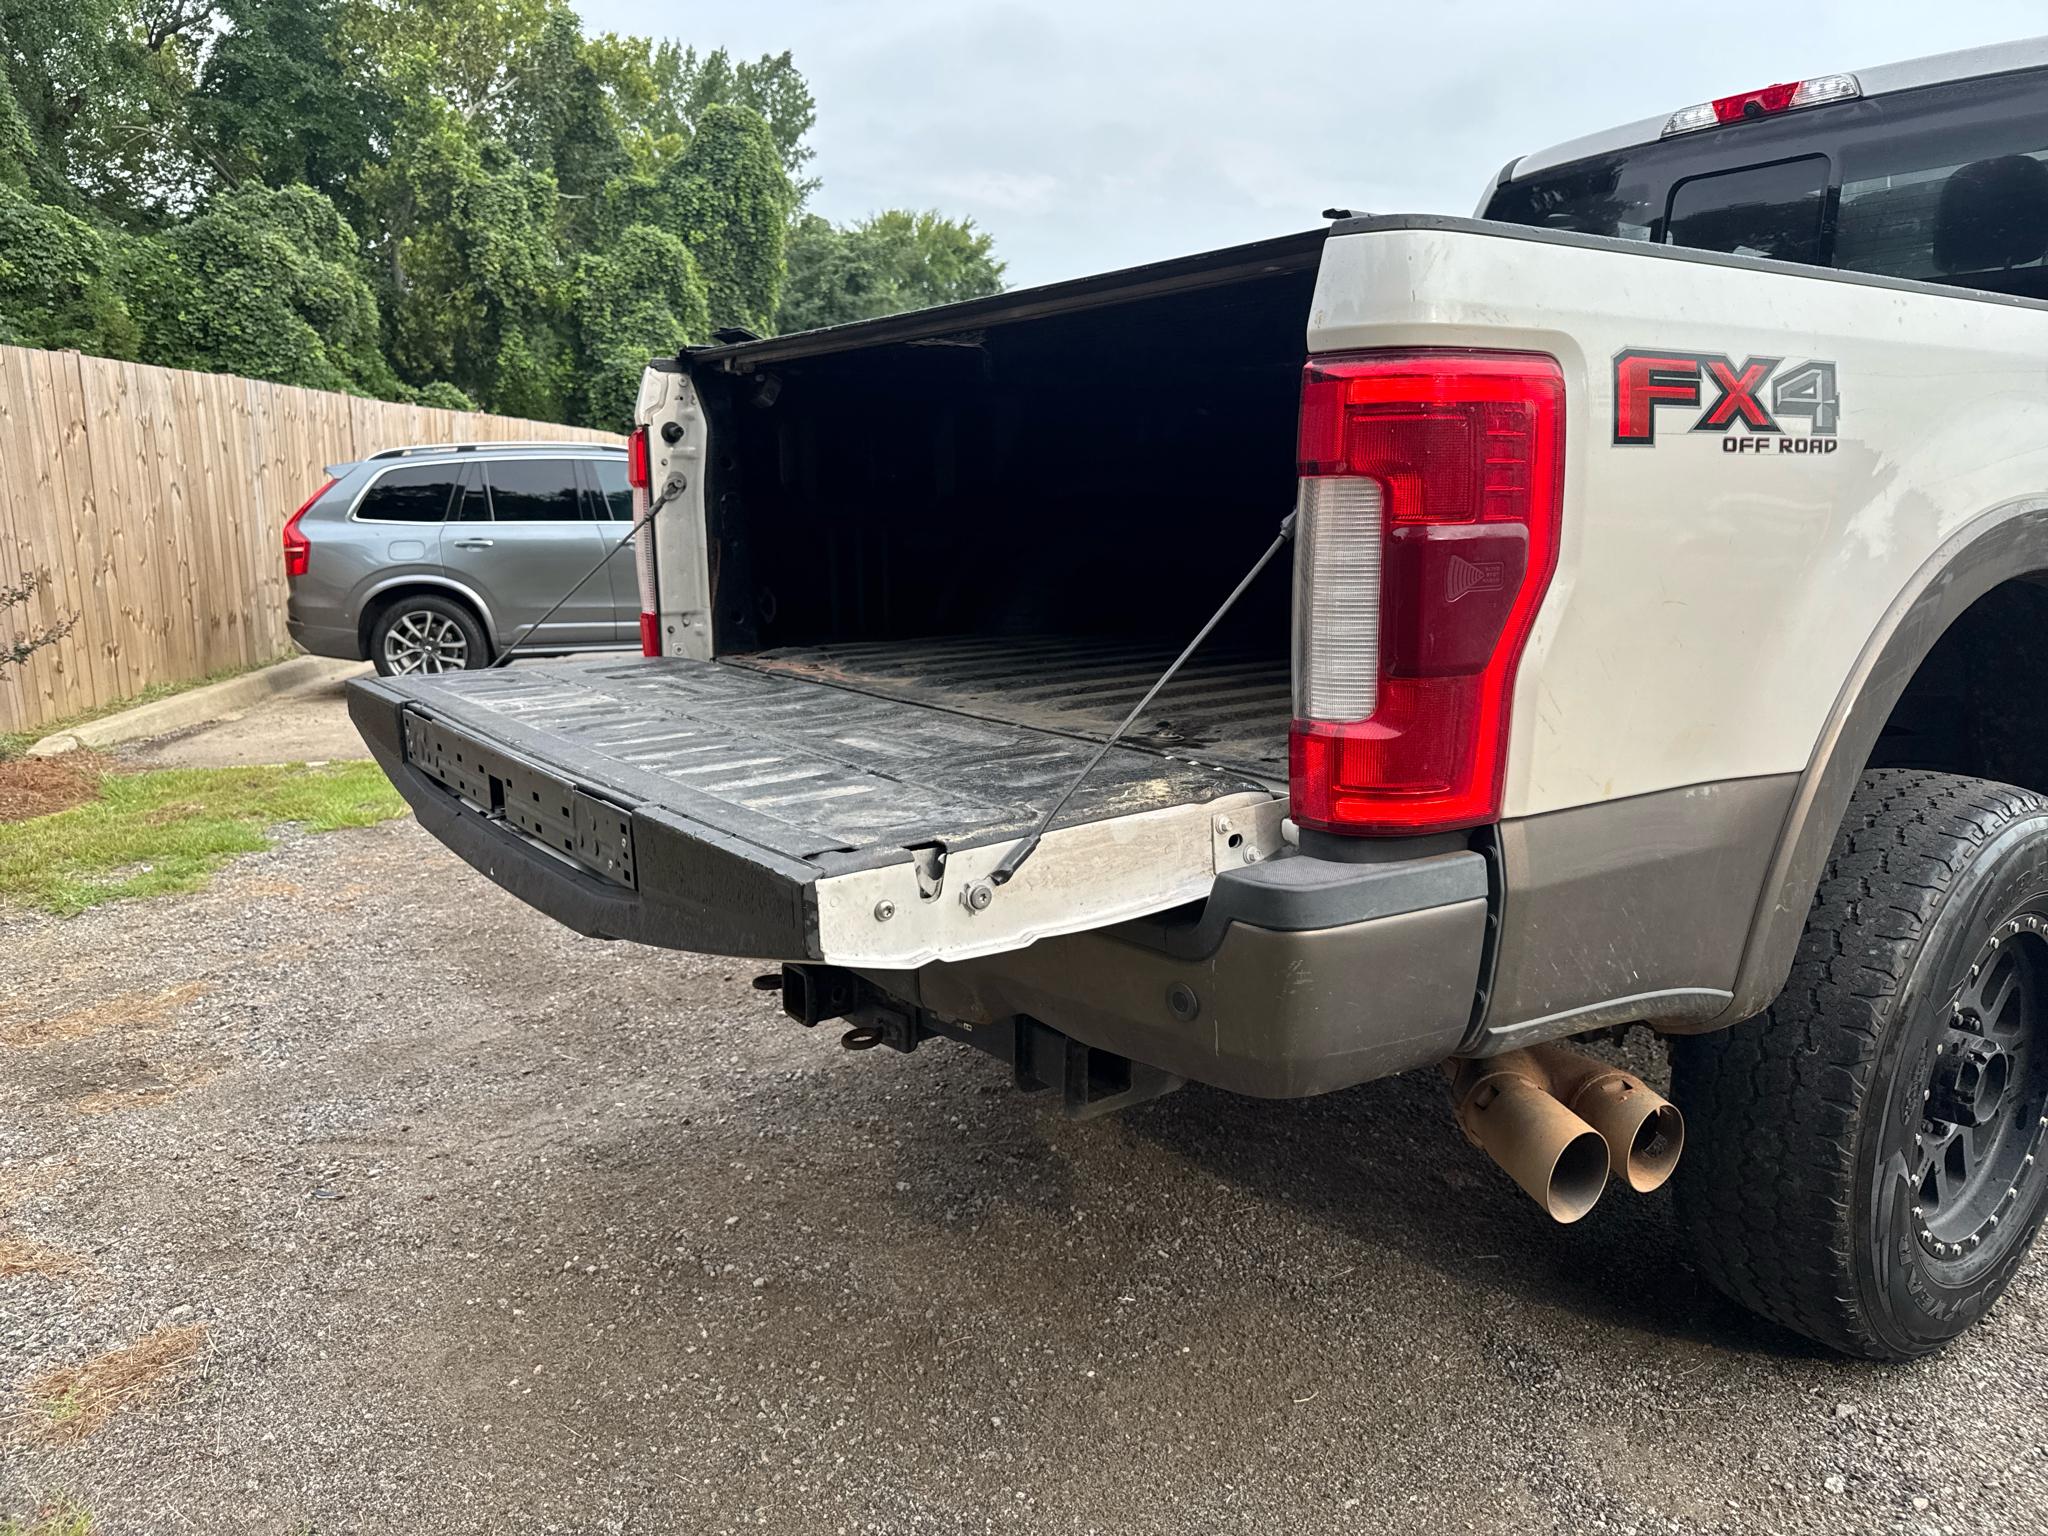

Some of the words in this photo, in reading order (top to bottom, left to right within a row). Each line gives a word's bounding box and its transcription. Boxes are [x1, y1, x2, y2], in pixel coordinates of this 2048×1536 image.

[1611, 346, 1839, 447] FX4
[1722, 437, 1770, 454] OFF
[1779, 438, 1838, 455] ROAD
